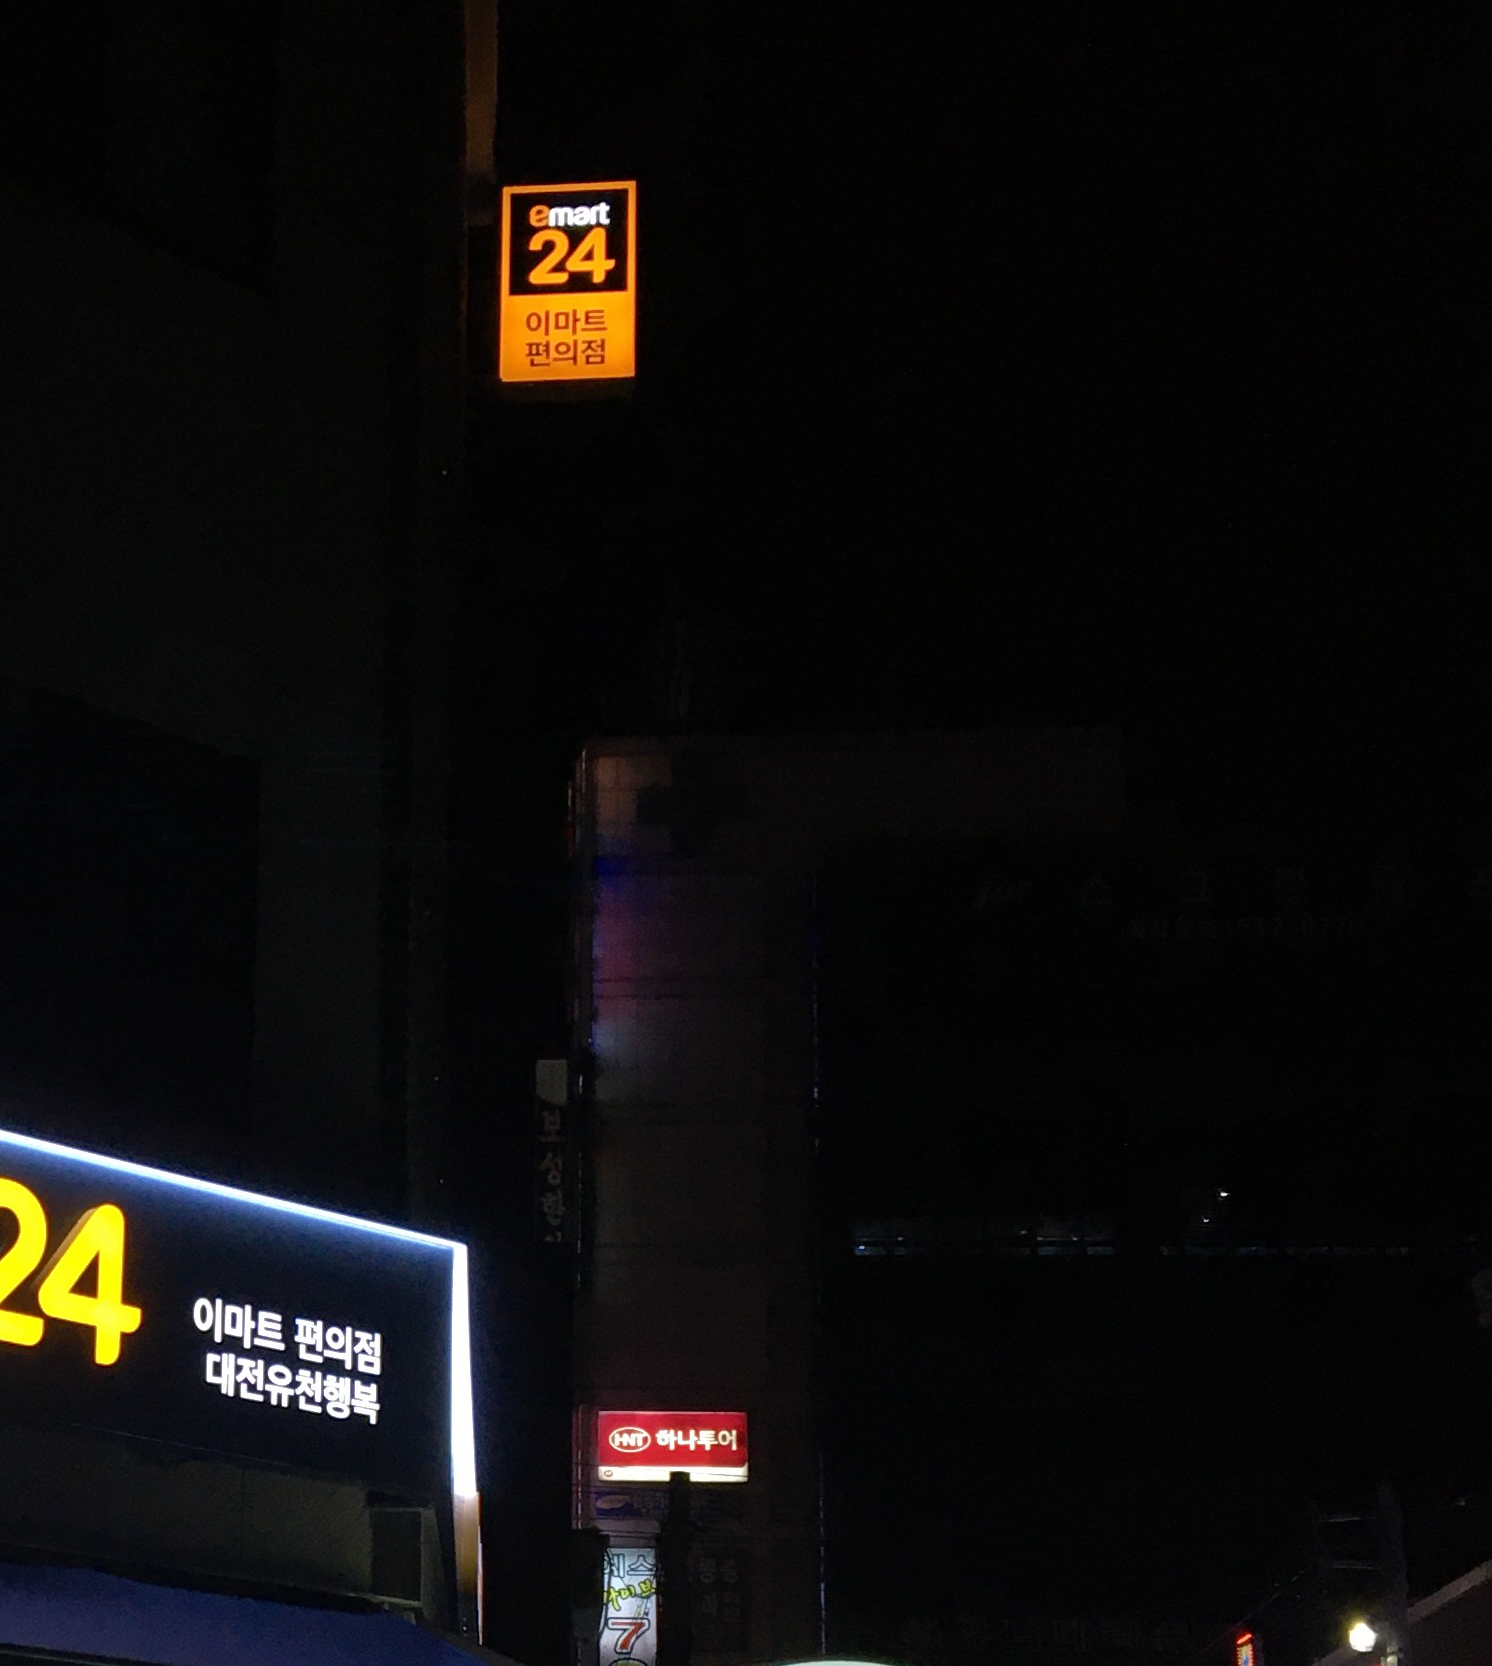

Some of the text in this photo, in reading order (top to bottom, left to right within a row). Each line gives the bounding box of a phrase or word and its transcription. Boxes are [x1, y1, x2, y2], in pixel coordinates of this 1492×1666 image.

[529, 202, 610, 227] emart
[528, 228, 616, 285] 24
[525, 309, 607, 336] 이마트
[525, 339, 606, 367] 편의점
[194, 1297, 383, 1377] 이마트 편의점
[206, 1353, 381, 1425] 대전유천행복
[656, 1430, 737, 1451] 하나투어
